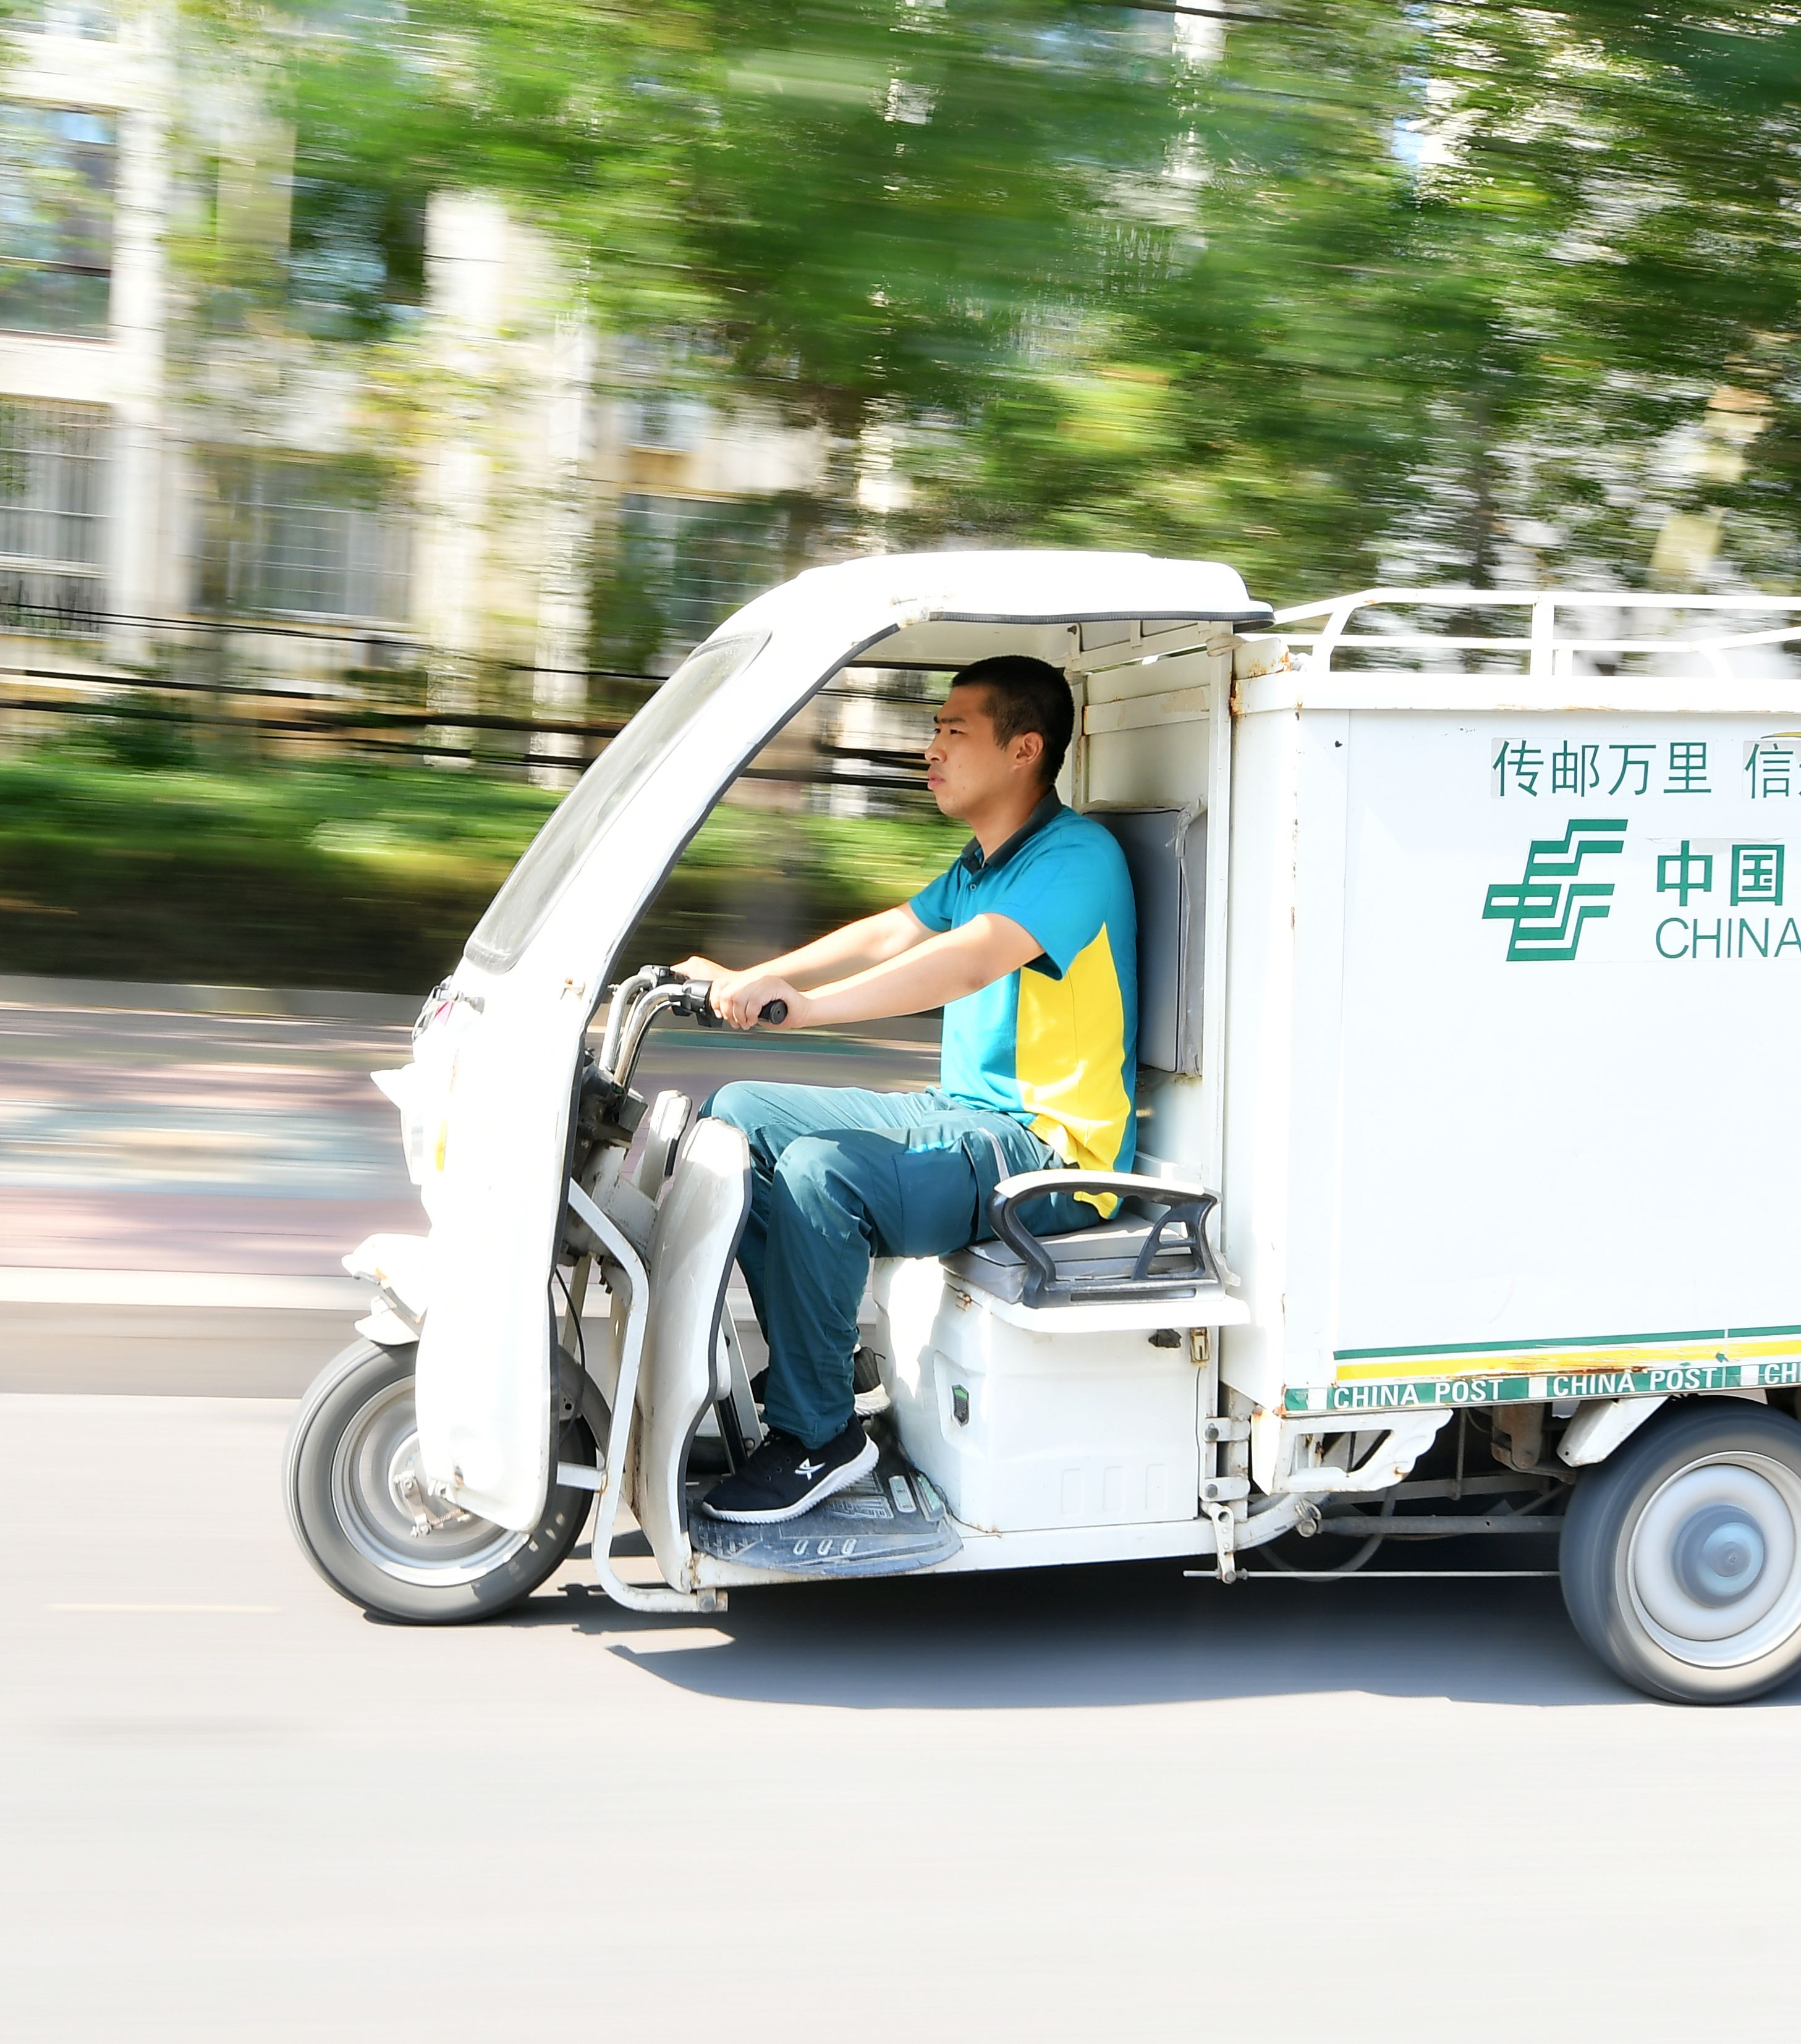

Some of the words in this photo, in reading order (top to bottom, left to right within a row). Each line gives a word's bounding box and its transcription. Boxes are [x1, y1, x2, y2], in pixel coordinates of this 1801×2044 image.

[1493, 740, 1711, 798] 传邮万里
[1744, 743, 1801, 800] 信
[1656, 840, 1785, 906] 中国
[1656, 918, 1801, 959] CHINA
[1553, 1371, 1635, 1397] CHINA
[1650, 1367, 1718, 1392] POST
[1764, 1362, 1801, 1385] CH
[1334, 1384, 1419, 1409] CHINA
[1434, 1379, 1504, 1403] POST
